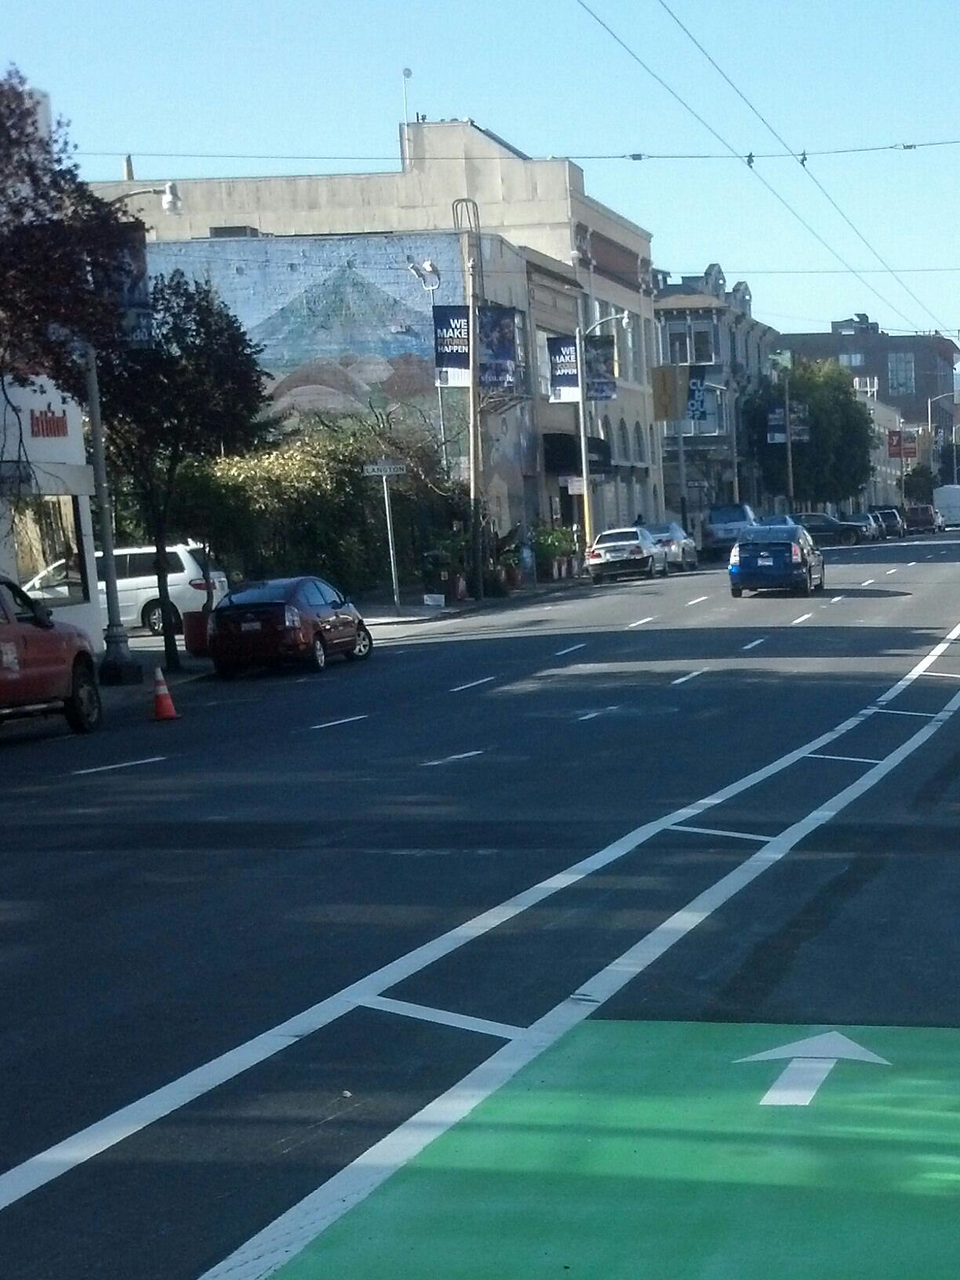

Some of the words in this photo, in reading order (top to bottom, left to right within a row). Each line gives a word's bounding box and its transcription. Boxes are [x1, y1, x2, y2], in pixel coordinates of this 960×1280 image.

[450, 319, 468, 329] WE
[437, 328, 468, 338] MAKE
[438, 345, 469, 353] HAPPEN
[561, 346, 576, 355] WE
